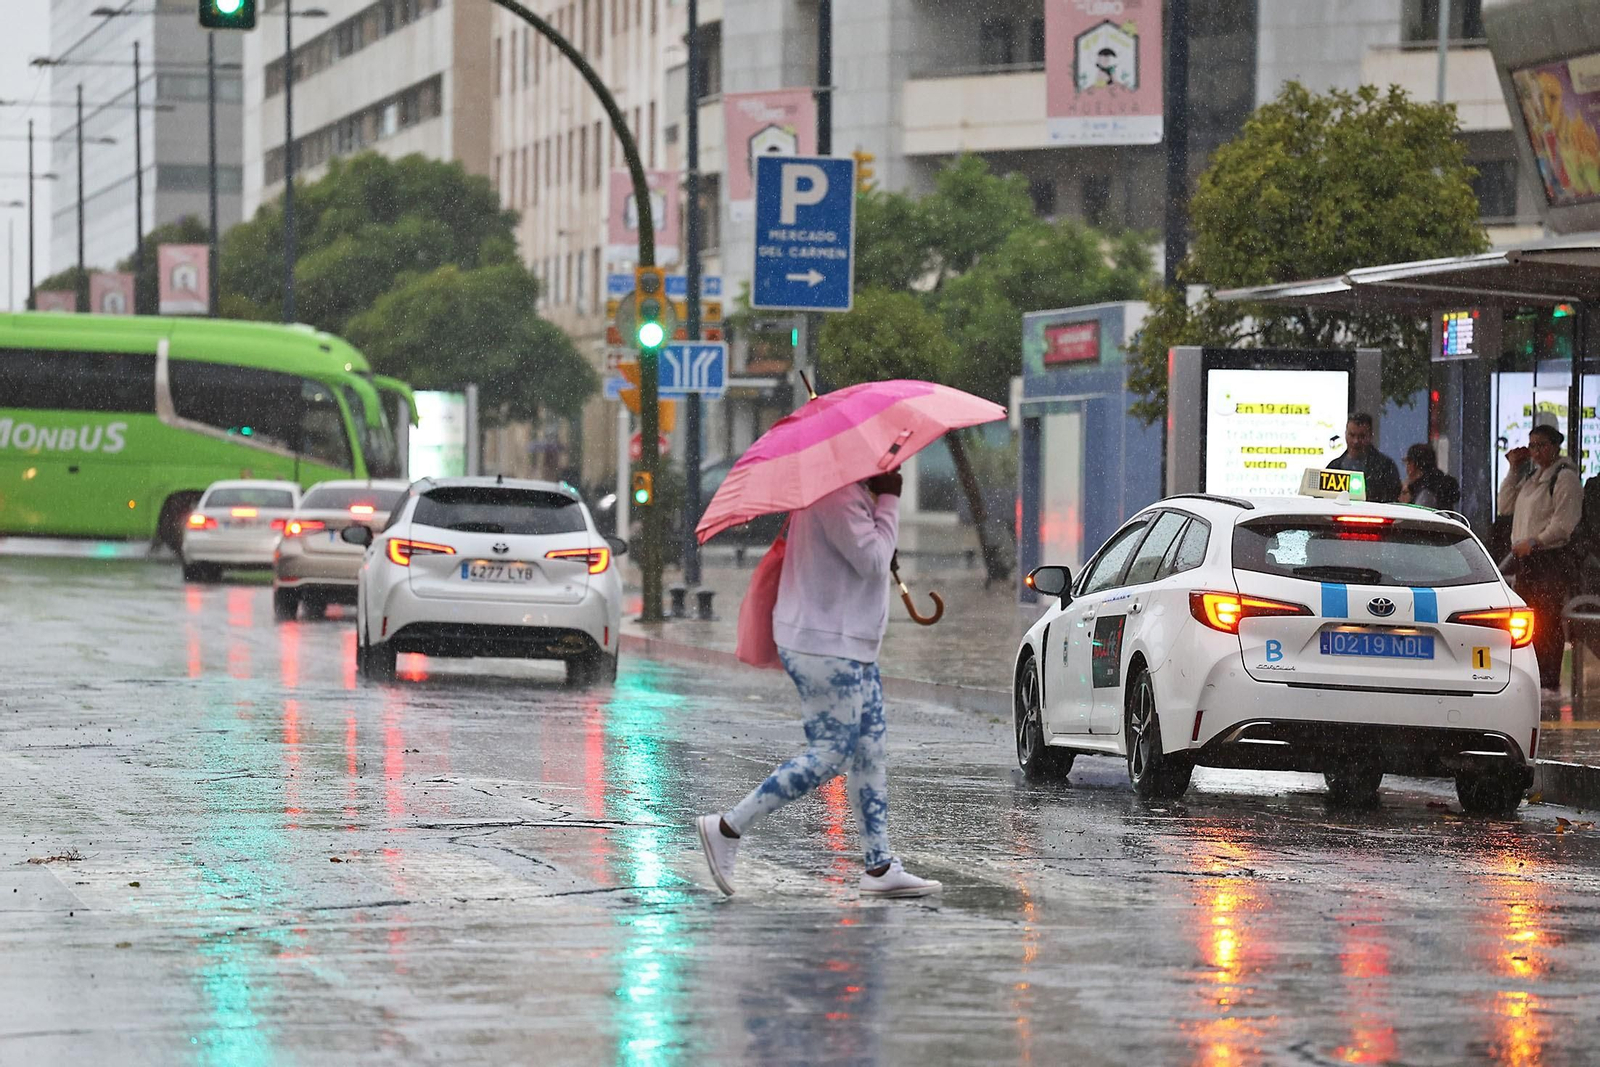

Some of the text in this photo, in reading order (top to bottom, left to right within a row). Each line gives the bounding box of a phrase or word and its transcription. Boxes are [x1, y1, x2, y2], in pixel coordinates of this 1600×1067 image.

[780, 163, 829, 225] P
[768, 230, 837, 243] MERCADO
[758, 245, 848, 260] DEL CARMEN
[1235, 403, 1310, 415] En 19 días
[1227, 430, 1297, 440] tratamos
[1241, 445, 1324, 455] reciclamos
[1244, 459, 1287, 469] vidrio
[1321, 473, 1350, 491] TAXI
[470, 566, 533, 580] 4277 LYB
[1265, 639, 1283, 662] B
[1334, 635, 1429, 656] 0219 NDL
[1477, 649, 1484, 667] 1
